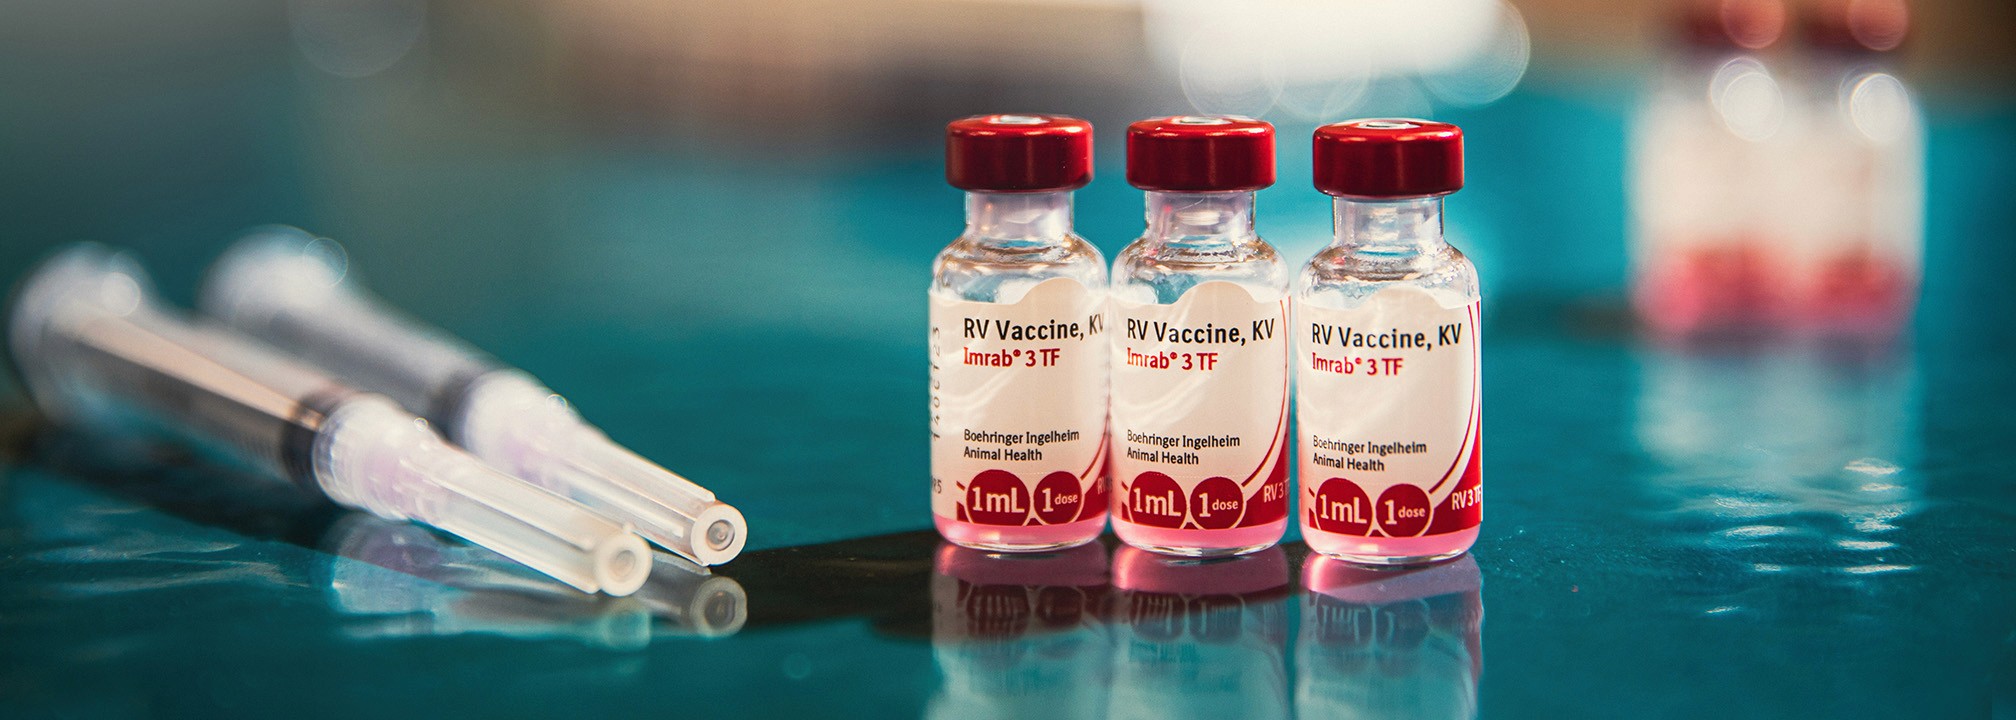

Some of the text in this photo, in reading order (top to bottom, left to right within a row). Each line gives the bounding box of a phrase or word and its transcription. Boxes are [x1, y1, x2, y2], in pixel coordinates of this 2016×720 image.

[964, 312, 1105, 341] RV Vaccine, KV
[1127, 317, 1275, 346] RV Vaccine, KV
[1312, 322, 1462, 351] RV Vaccine, KV
[1025, 350, 1036, 367] 3
[1040, 348, 1060, 367] TF
[1182, 353, 1193, 371] 3
[1196, 352, 1218, 371] TF
[1367, 358, 1377, 376] 3
[1382, 357, 1403, 376] TF
[964, 428, 1079, 446] Boehringer Ingelheim
[1127, 429, 1240, 450] Boehringer Ingelheim
[1313, 434, 1427, 456] Boehringer Ingelheim
[964, 446, 1042, 461] Animal Health
[1127, 446, 1199, 465] Animal Health
[1313, 452, 1385, 472] Animal Health
